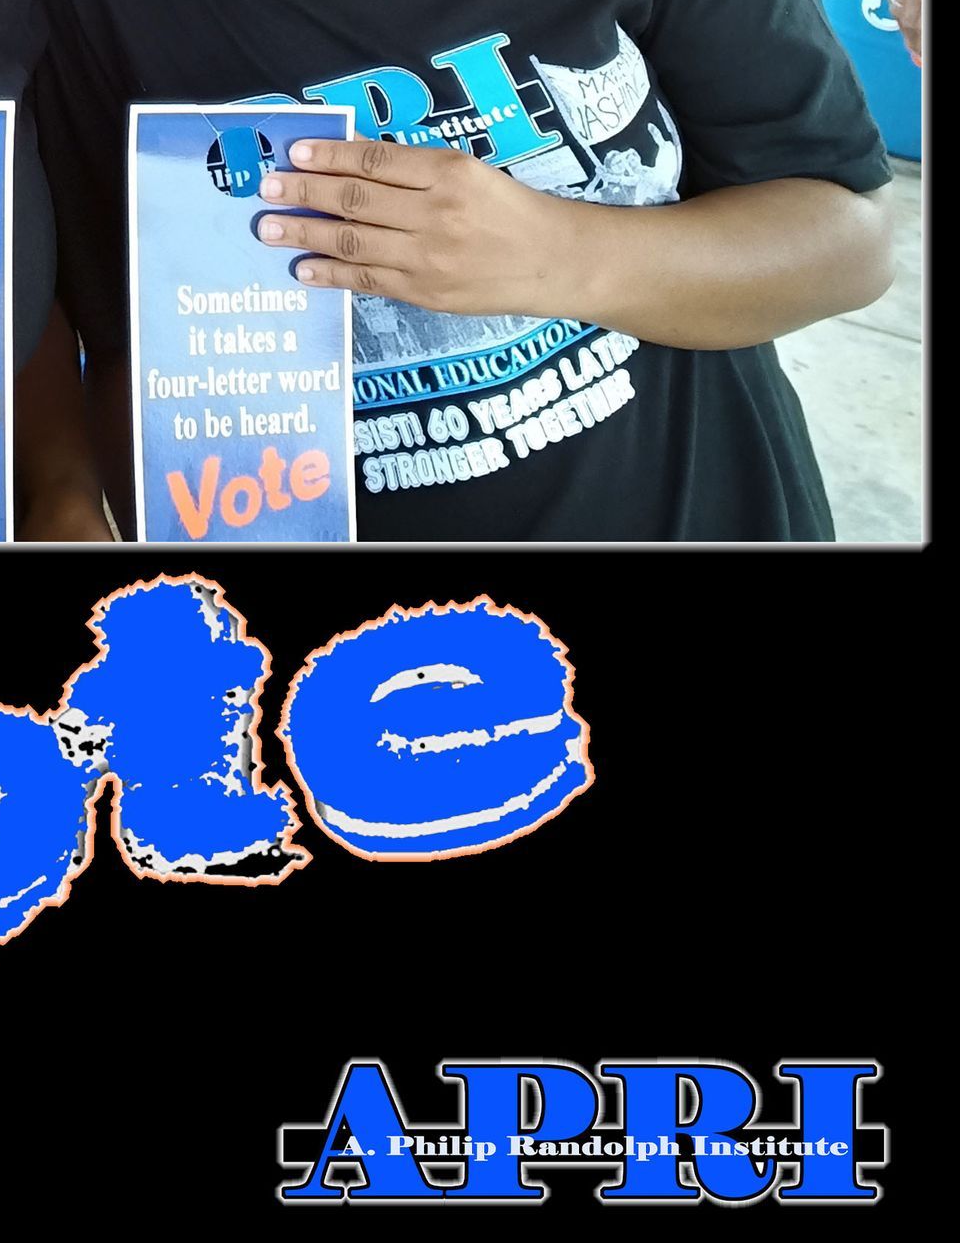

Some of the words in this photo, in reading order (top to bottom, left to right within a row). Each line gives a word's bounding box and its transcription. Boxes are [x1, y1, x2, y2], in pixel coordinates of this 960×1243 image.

[394, 102, 519, 147] Institute
[176, 283, 308, 316] Sometimes
[189, 325, 207, 356] it
[213, 324, 276, 355] takes
[282, 329, 297, 353] a
[146, 365, 272, 399] four-letter
[278, 362, 341, 393] word
[354, 411, 426, 456] SIST!
[427, 404, 470, 444] 60
[467, 367, 563, 435] YEARS
[558, 330, 640, 392] LATER
[173, 411, 198, 441] to
[204, 407, 233, 439] be
[240, 403, 317, 436] heard.
[362, 436, 511, 494] STRONGER
[505, 368, 637, 459] TOGETHER
[166, 445, 331, 540] Vote
